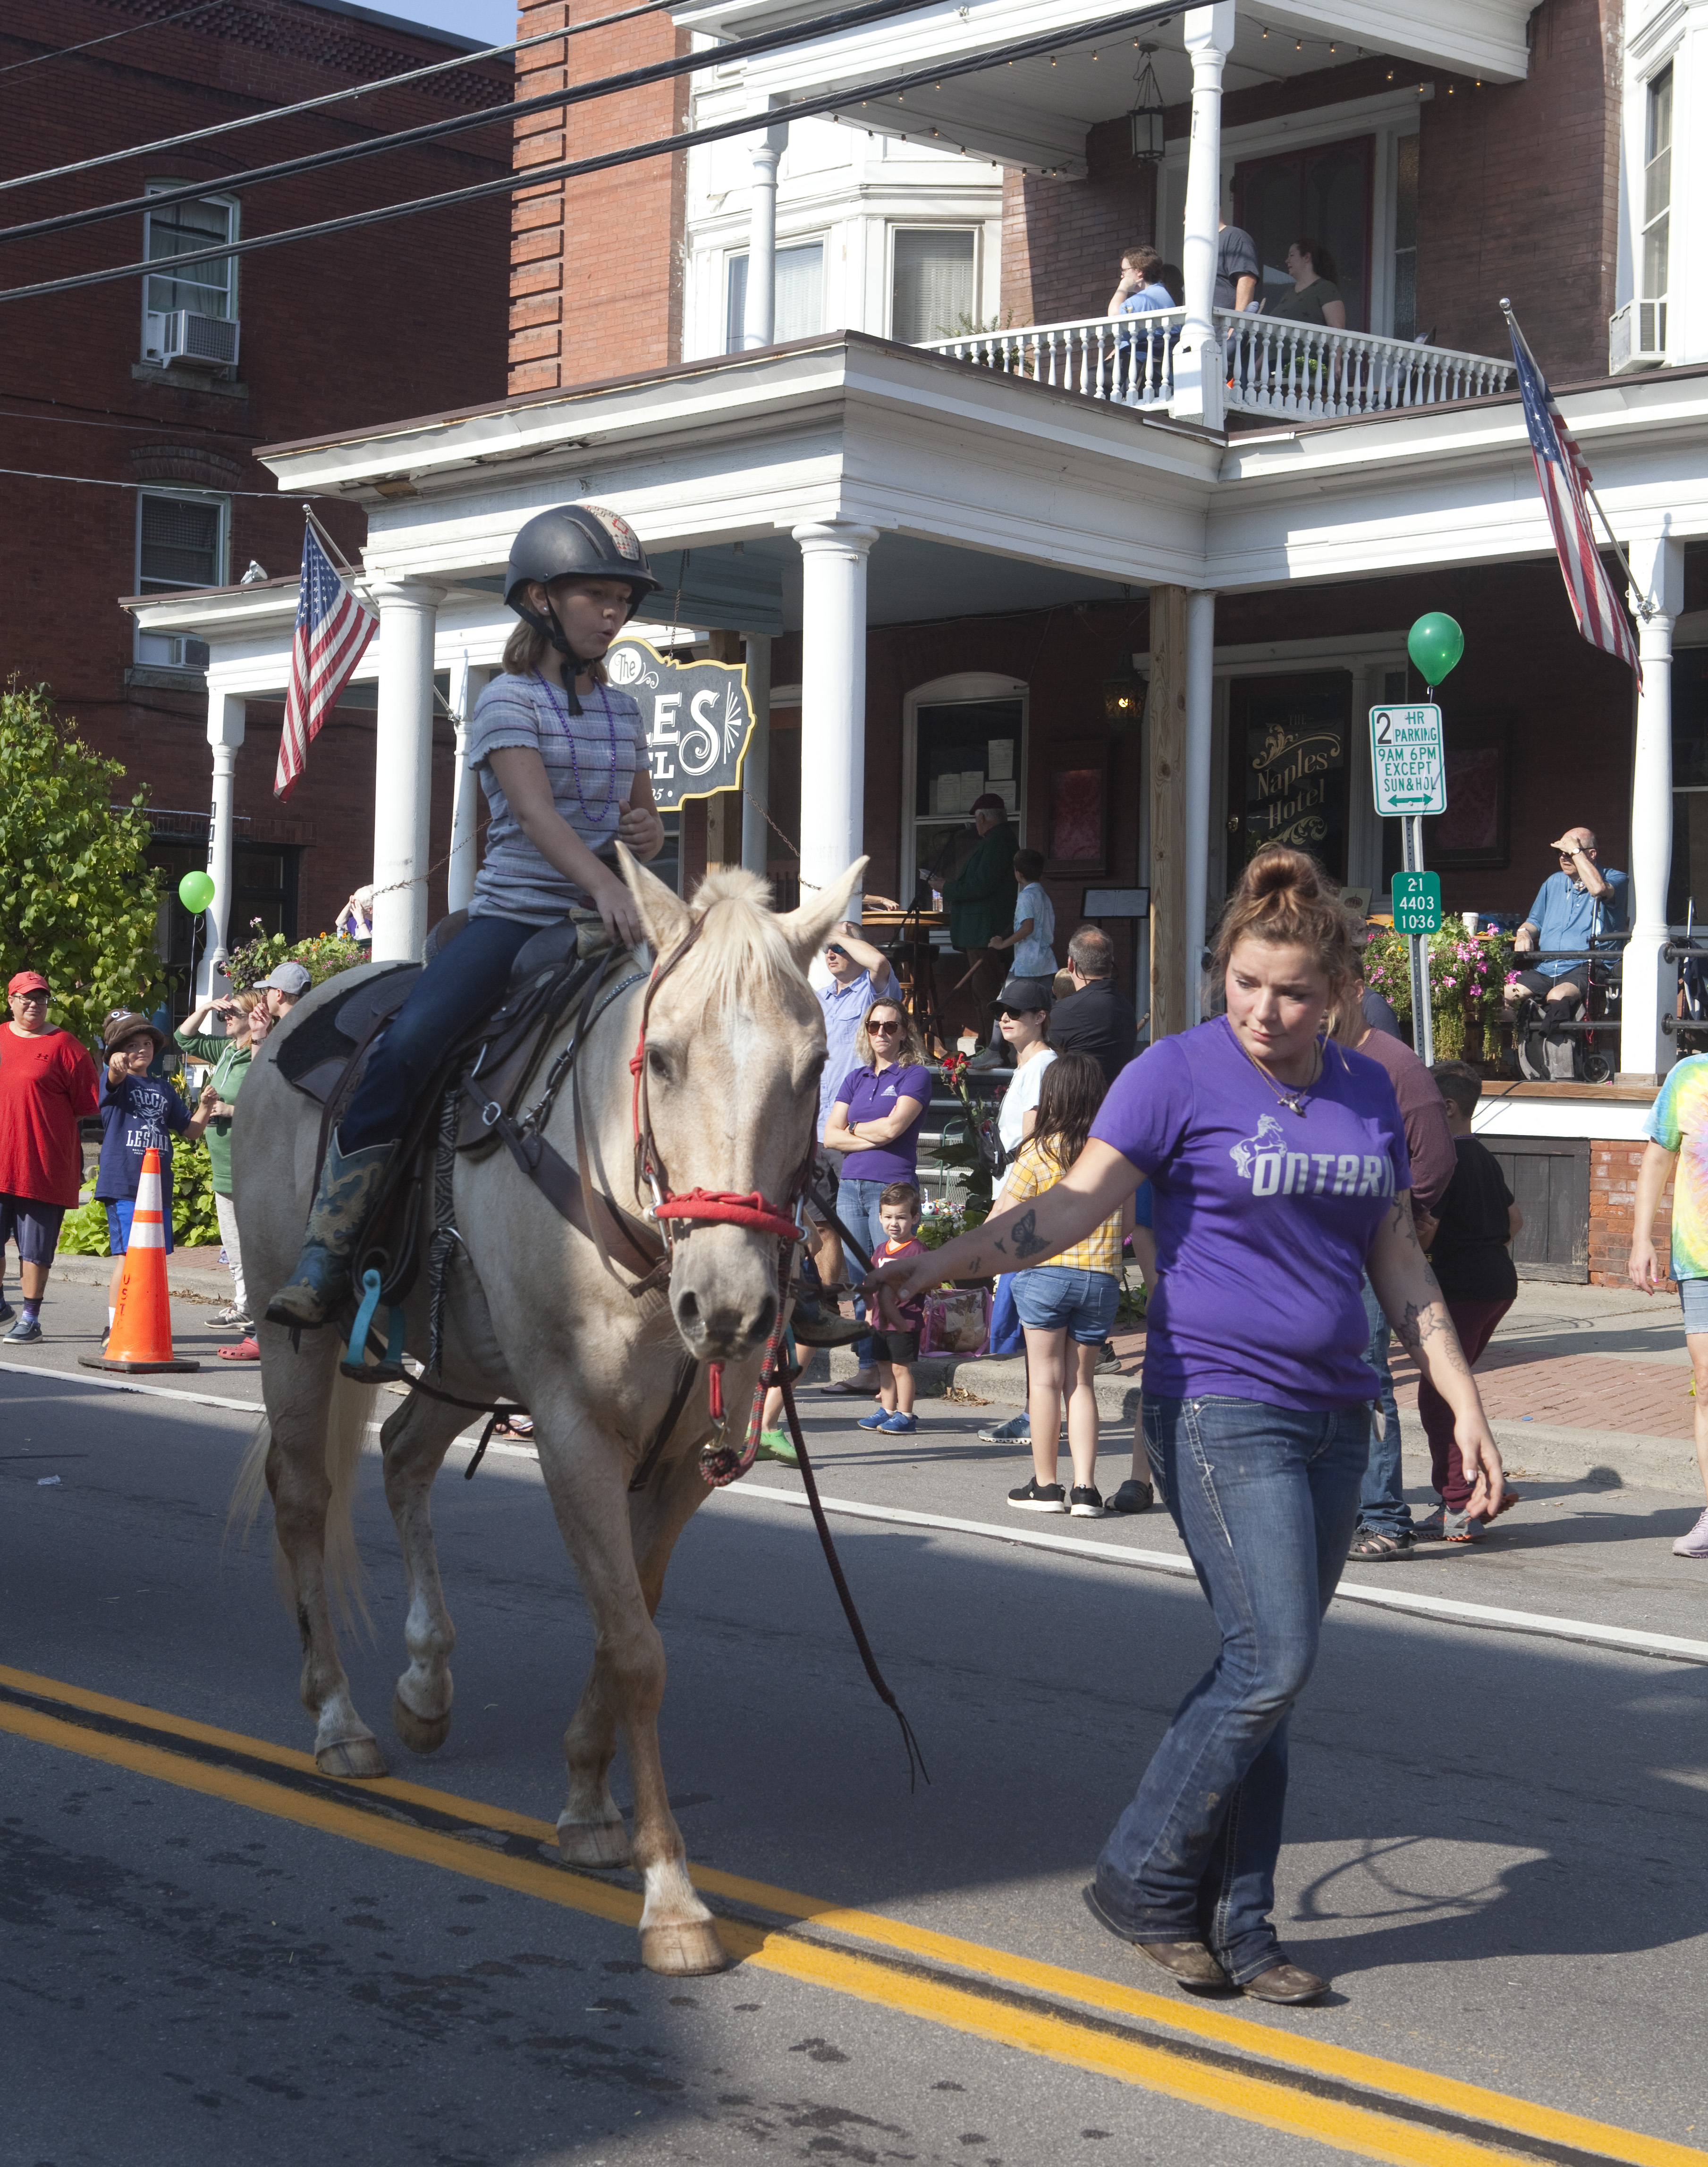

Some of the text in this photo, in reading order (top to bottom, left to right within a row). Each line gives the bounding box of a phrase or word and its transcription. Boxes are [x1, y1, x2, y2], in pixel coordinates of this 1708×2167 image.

[614, 653, 635, 681] The
[1289, 714, 1307, 725] THE
[646, 690, 720, 776] ES
[1377, 711, 1424, 744] 2 HR
[1395, 727, 1437, 742] PARKING
[1378, 747, 1436, 761] 9AM 6PM
[1256, 748, 1328, 801] Naples
[1385, 761, 1431, 776] EXCEPT
[1268, 778, 1325, 829] Hotel
[1408, 878, 1422, 891] 21
[1399, 896, 1434, 910] 4403
[1402, 915, 1435, 929] 1036
[126, 1130, 169, 1152] LESNAR
